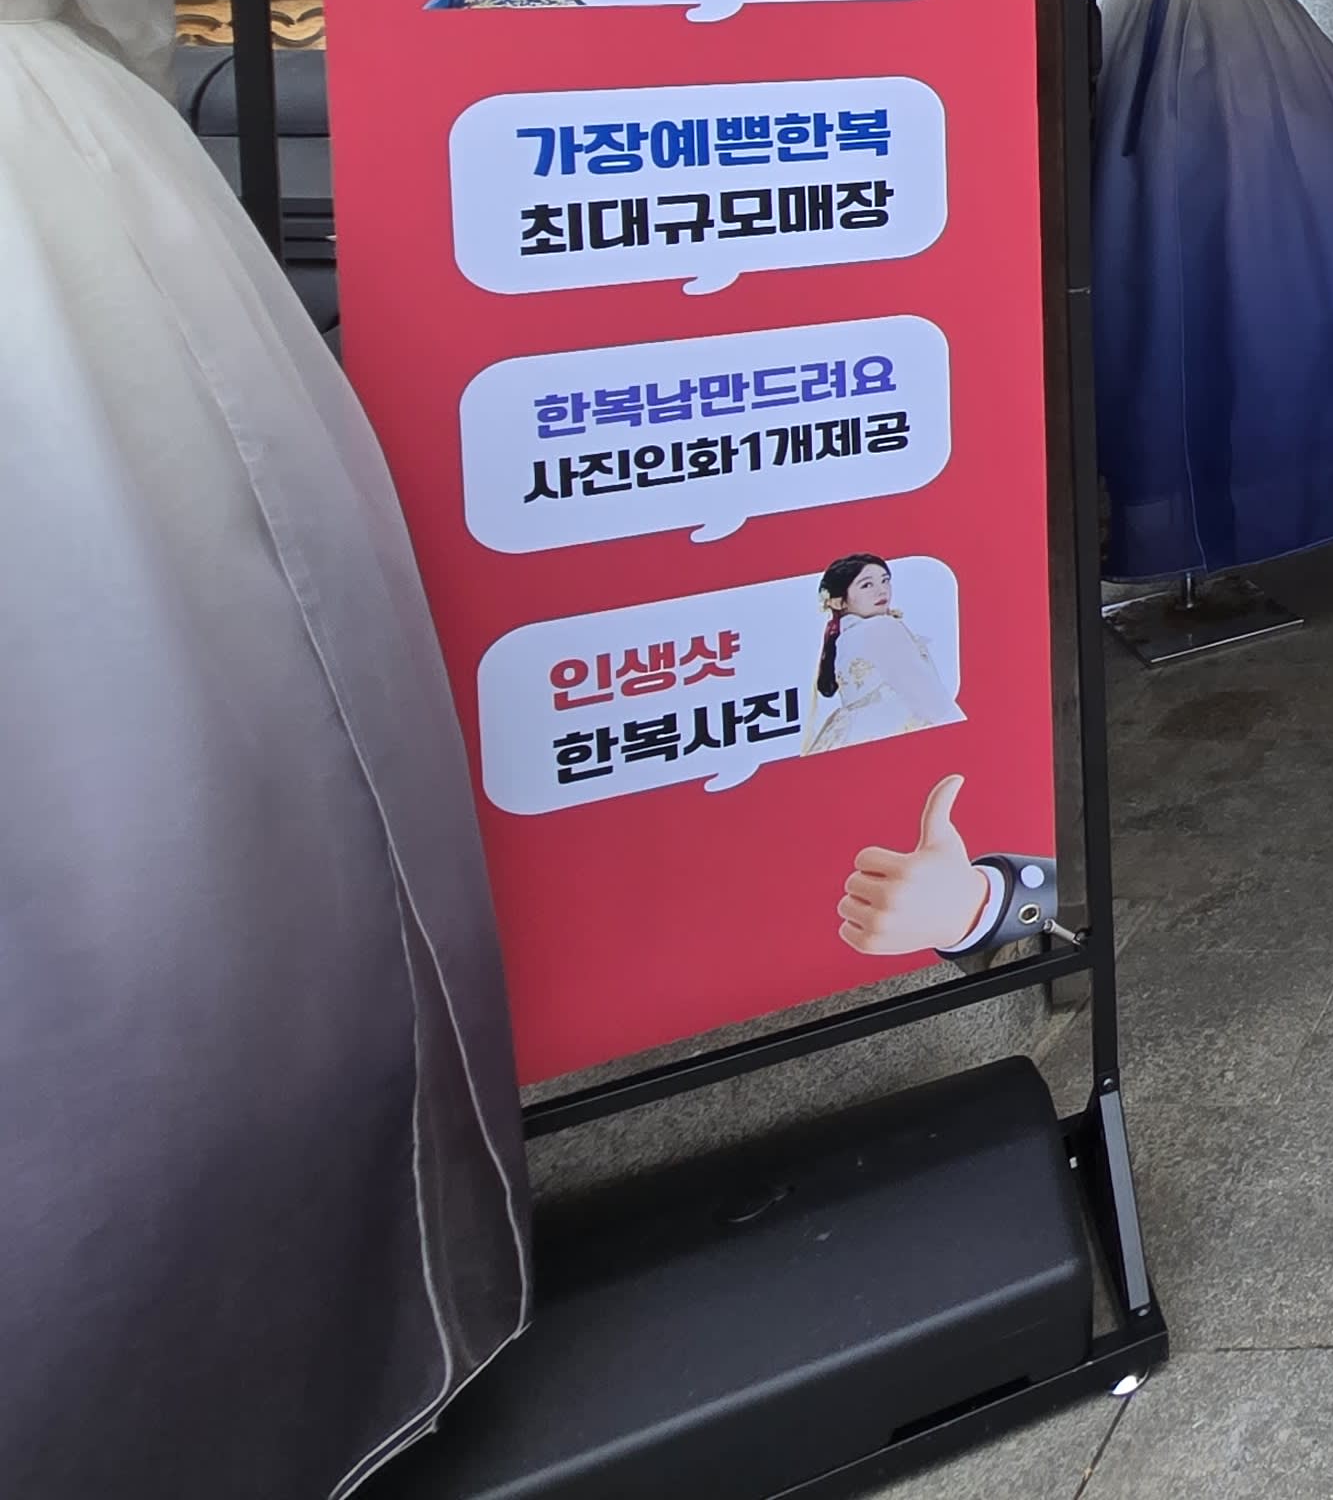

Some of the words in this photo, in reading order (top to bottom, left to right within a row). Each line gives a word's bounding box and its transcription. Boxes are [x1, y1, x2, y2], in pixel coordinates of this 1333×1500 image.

[515, 107, 893, 179] 가장예쁜한복
[518, 180, 895, 257] 최대규모매장
[532, 354, 898, 440] 한복남만드려요
[523, 412, 911, 505] 사진인화1개제공
[549, 631, 742, 712] 인생샷
[552, 688, 802, 786] 한복사진
